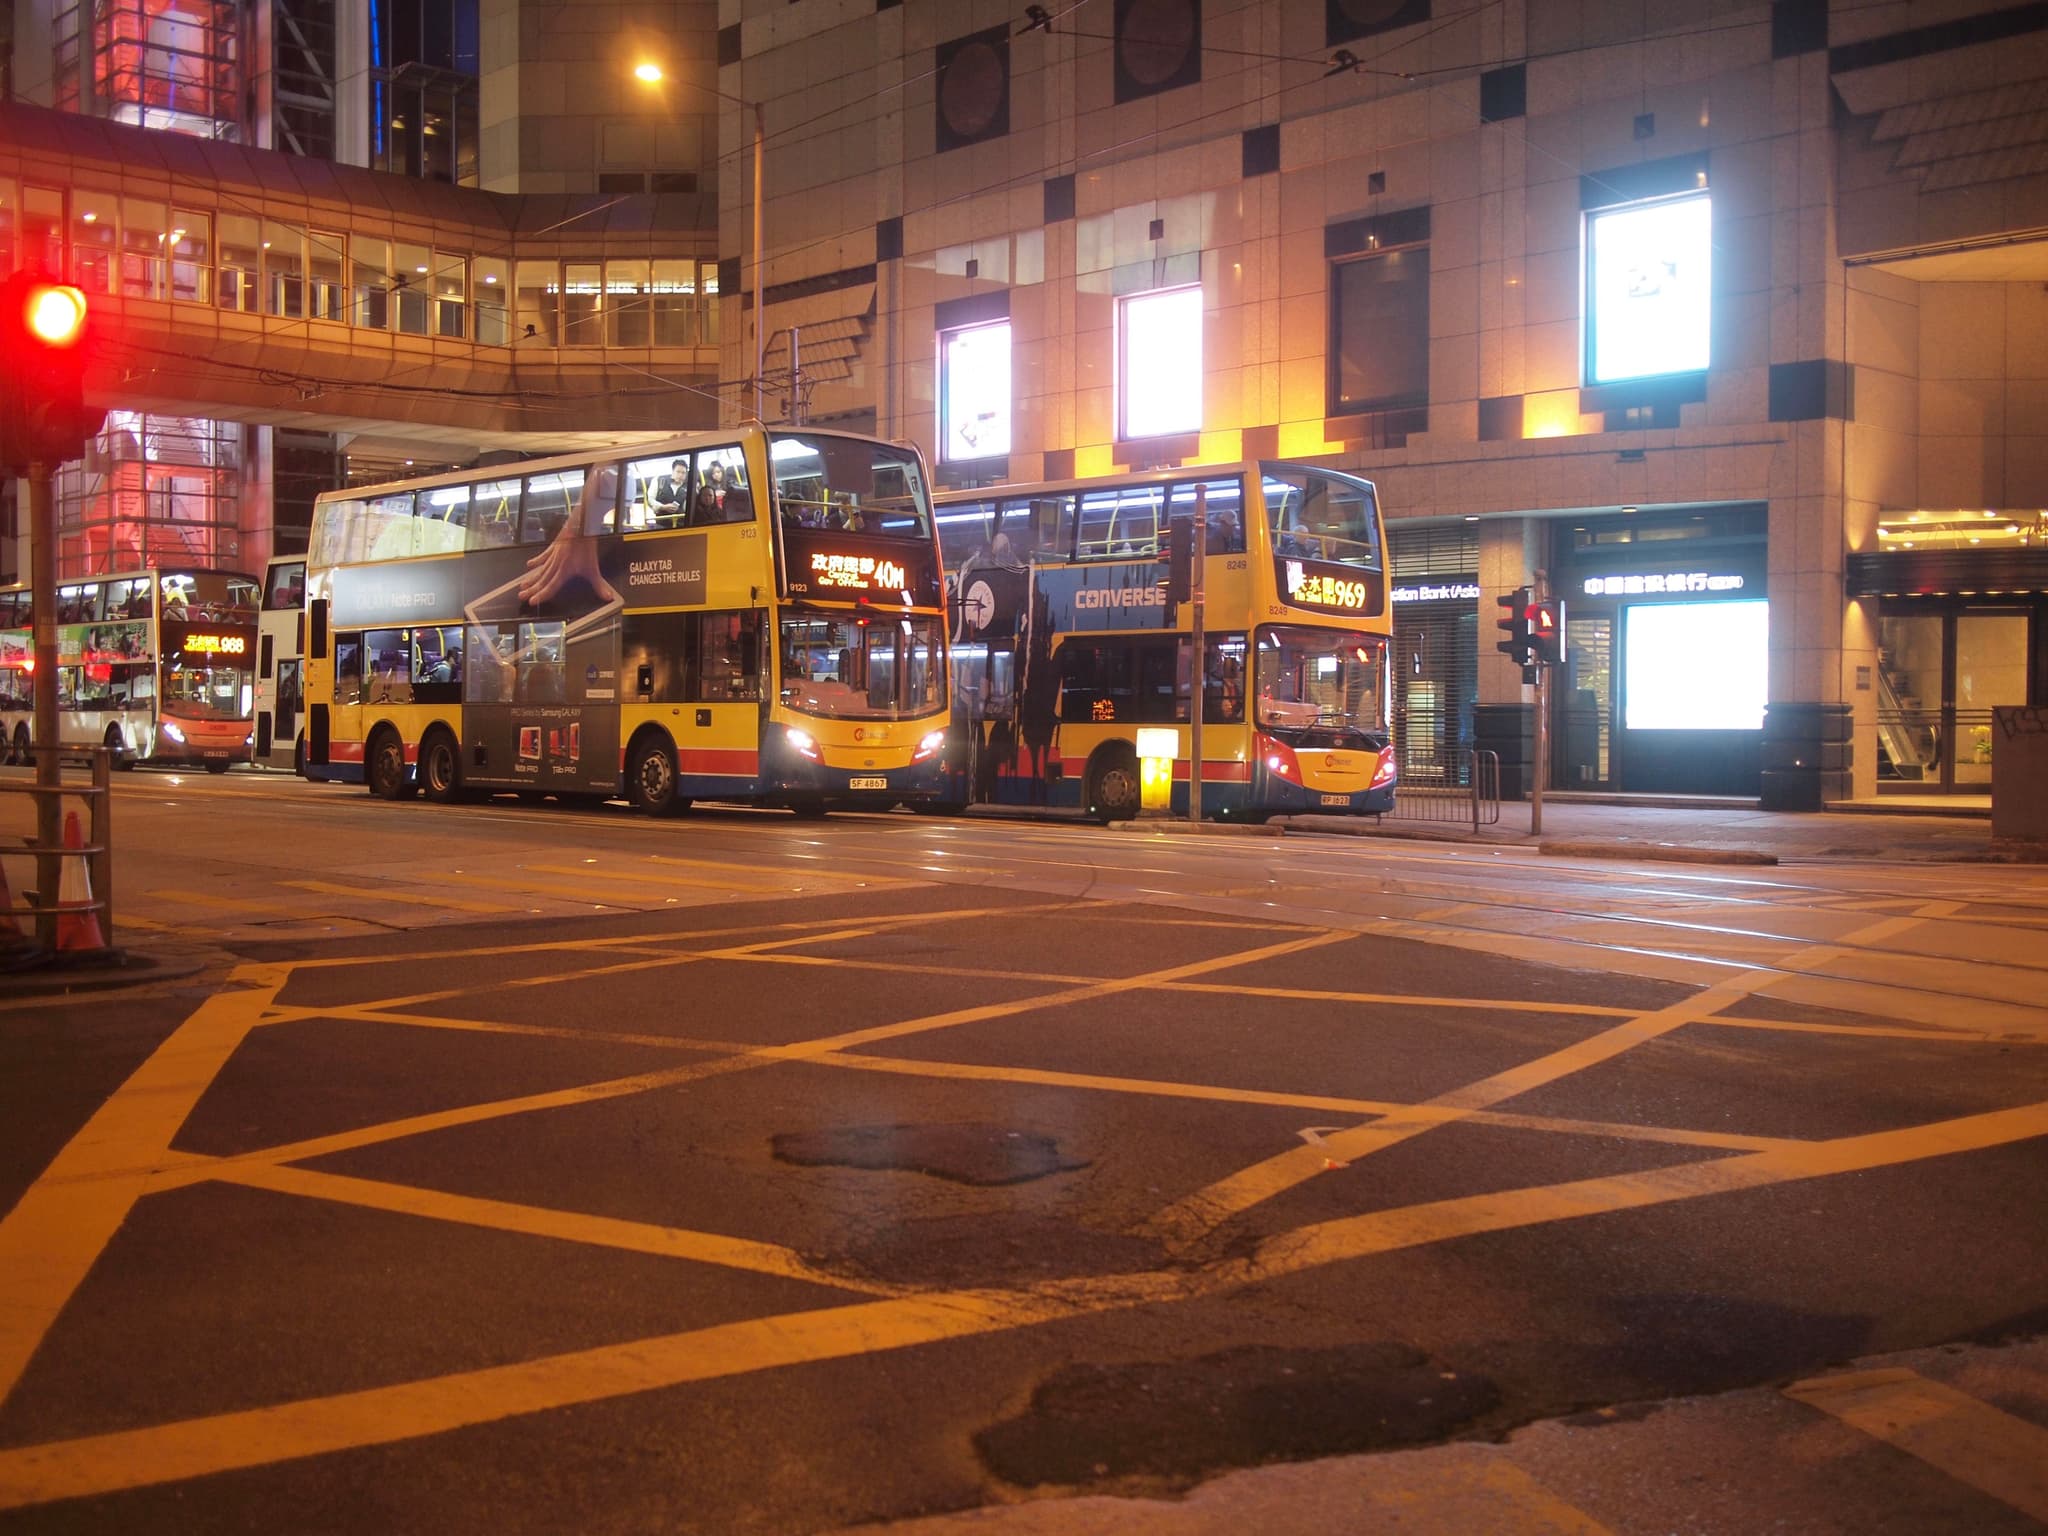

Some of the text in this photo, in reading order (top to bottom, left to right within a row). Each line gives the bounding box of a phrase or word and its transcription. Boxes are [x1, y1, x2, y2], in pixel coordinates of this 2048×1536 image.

[740, 528, 757, 539] 9123
[629, 559, 672, 573] GALAXY TAB
[1227, 560, 1247, 570] 8249
[629, 569, 701, 586] CHANGES THE RULES
[874, 560, 905, 589] 40M
[790, 583, 808, 592] 9123
[1335, 580, 1366, 609] 969
[1419, 586, 1450, 600] Bank
[413, 592, 436, 607] PRO
[1075, 587, 1167, 609] CONVERSE
[1269, 606, 1288, 616] 8249
[221, 636, 245, 653] 968
[851, 779, 885, 788] SF 4867
